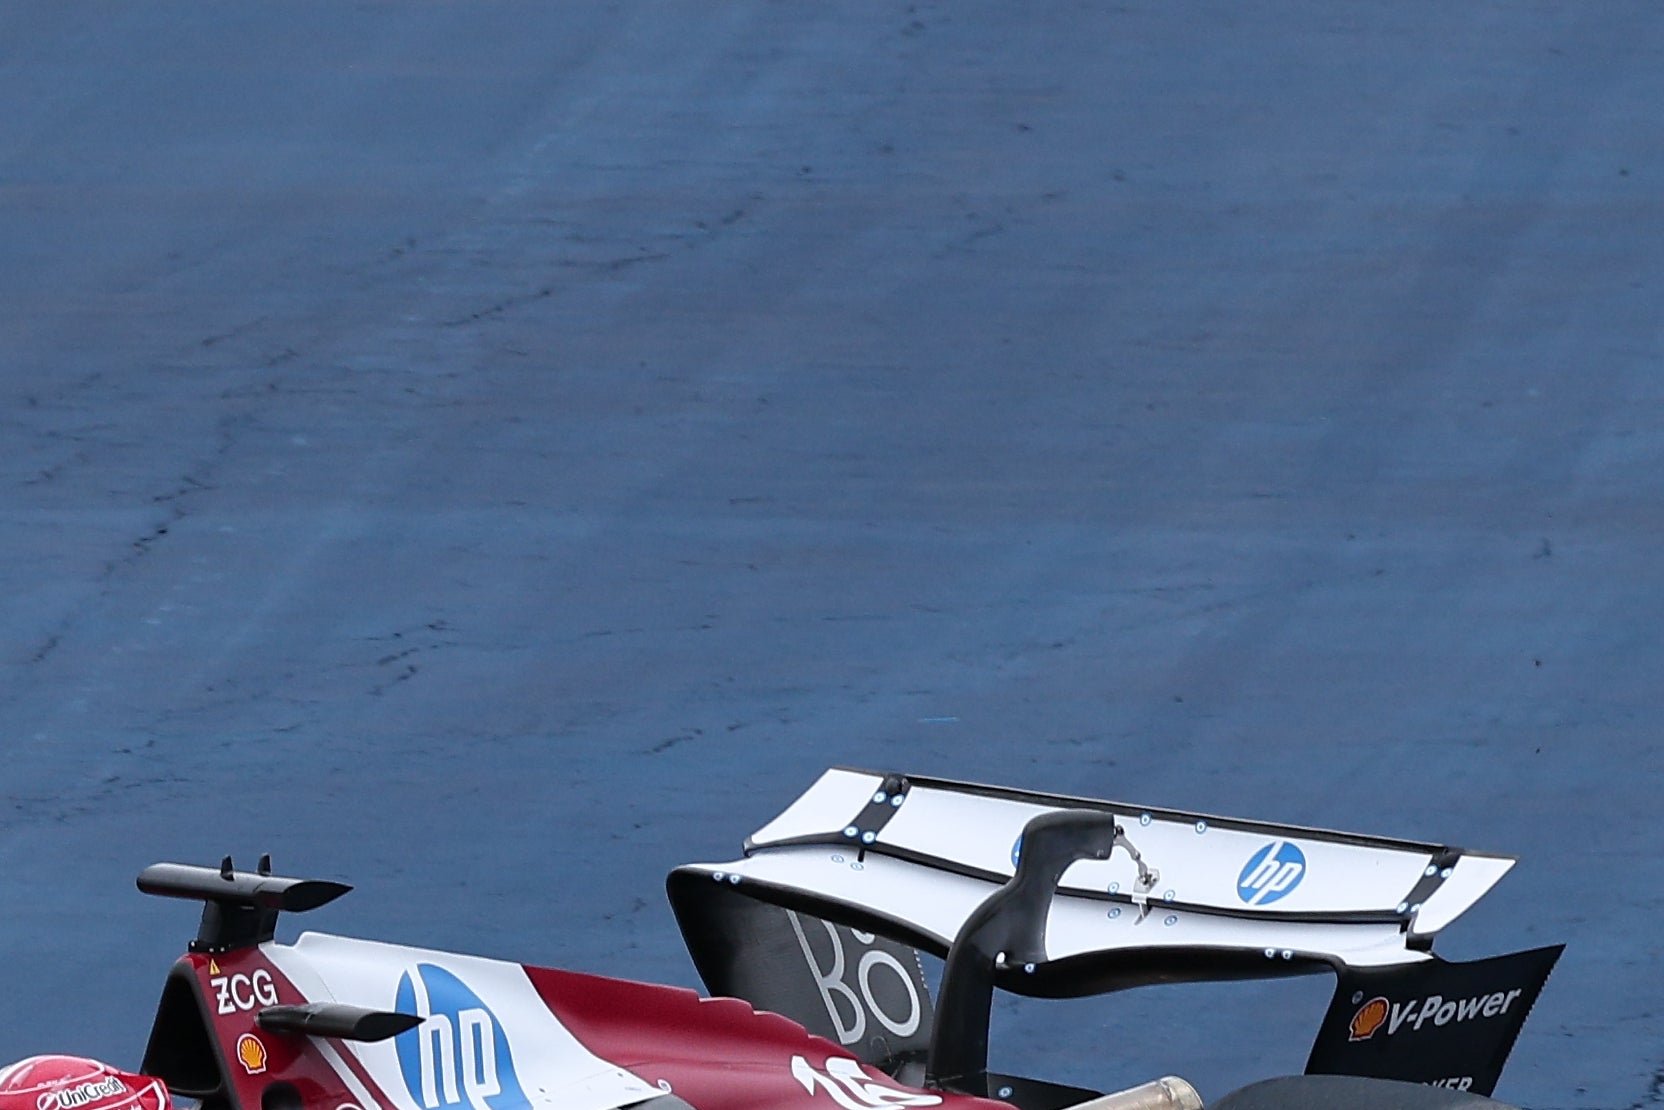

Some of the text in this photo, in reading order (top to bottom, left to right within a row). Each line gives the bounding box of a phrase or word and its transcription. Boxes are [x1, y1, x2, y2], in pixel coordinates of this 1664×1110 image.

[1237, 841, 1306, 905] hp
[210, 969, 278, 1014] ZCG
[1386, 986, 1522, 1035] V-Power
[59, 1075, 127, 1109] UniCredit
